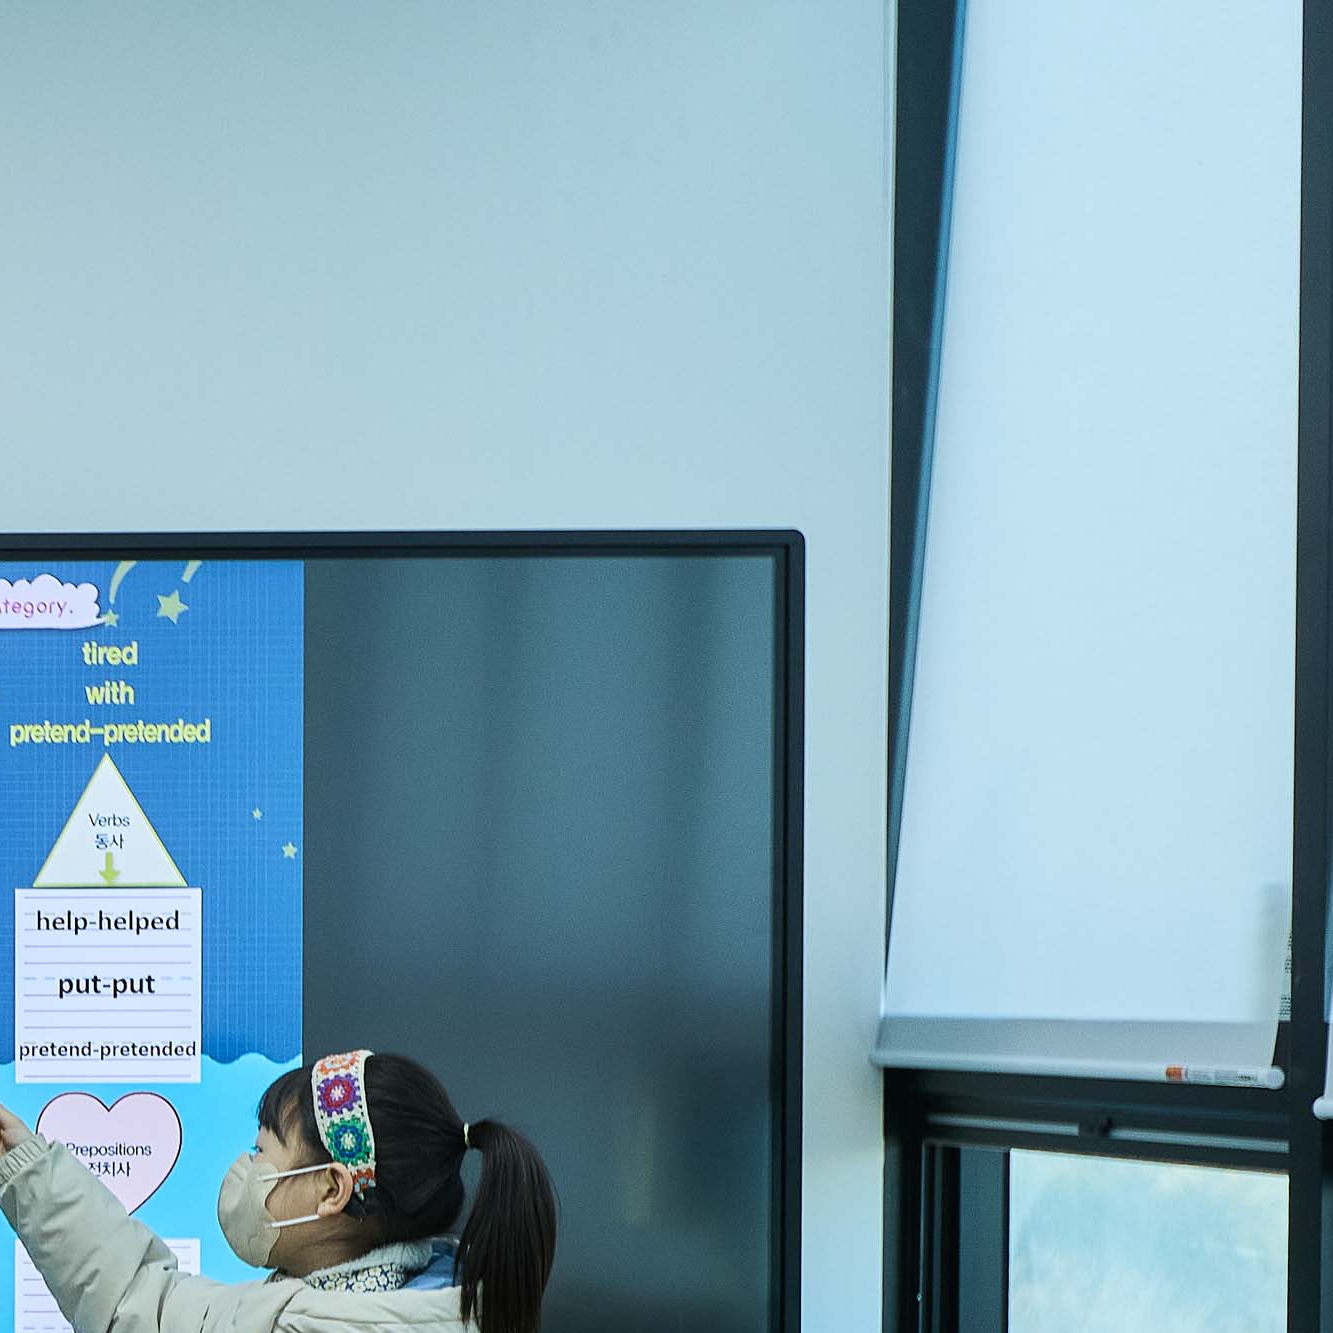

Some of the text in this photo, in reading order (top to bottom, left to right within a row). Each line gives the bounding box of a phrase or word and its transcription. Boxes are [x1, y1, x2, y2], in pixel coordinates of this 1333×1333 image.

[82, 641, 138, 666] tired
[86, 682, 134, 705] with
[10, 720, 211, 747] pretend-pretended
[88, 813, 131, 828] Verbs
[95, 833, 124, 850] 동사
[36, 909, 180, 936] help-helped
[58, 974, 156, 999] put-put
[19, 1040, 197, 1061] pretend-pretended
[66, 1142, 152, 1158] Prepositions
